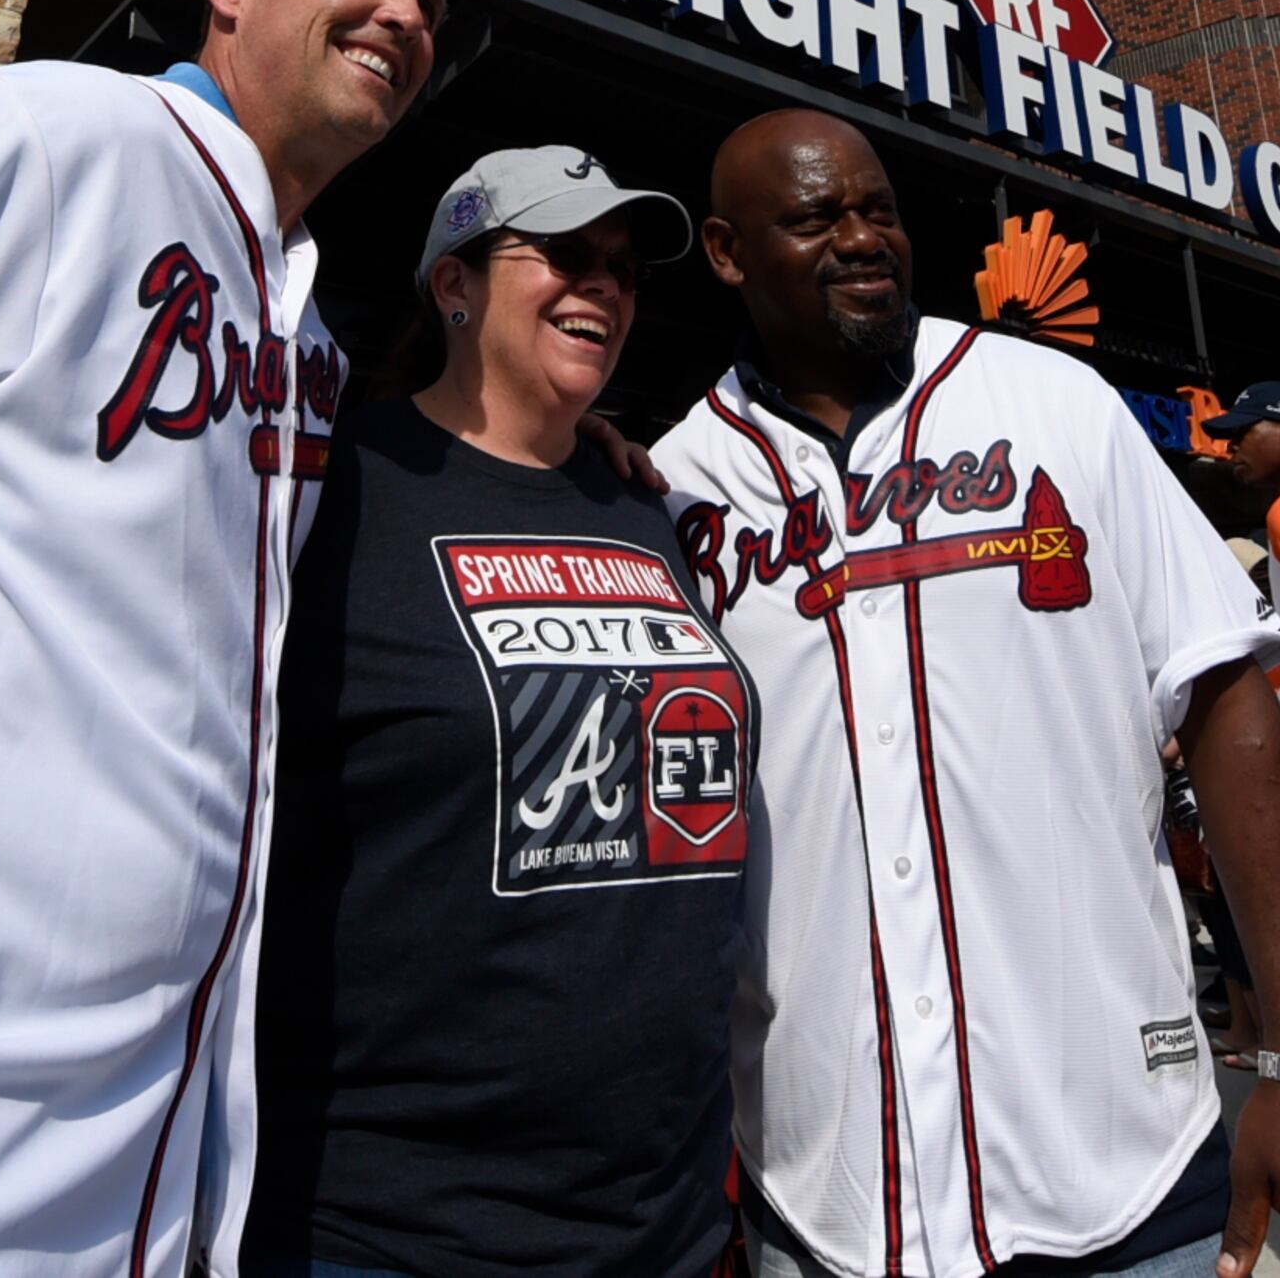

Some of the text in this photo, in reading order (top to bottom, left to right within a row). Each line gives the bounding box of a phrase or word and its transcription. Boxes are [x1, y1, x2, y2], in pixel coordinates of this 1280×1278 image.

[986, 22, 1234, 211] FIELD
[676, 438, 1018, 625] Braves
[457, 553, 679, 604] SPRING TRAINING
[486, 616, 637, 657] 2017
[518, 692, 627, 831] A
[655, 736, 735, 799] FL
[519, 839, 630, 871] LAKE BUENA VISTA
